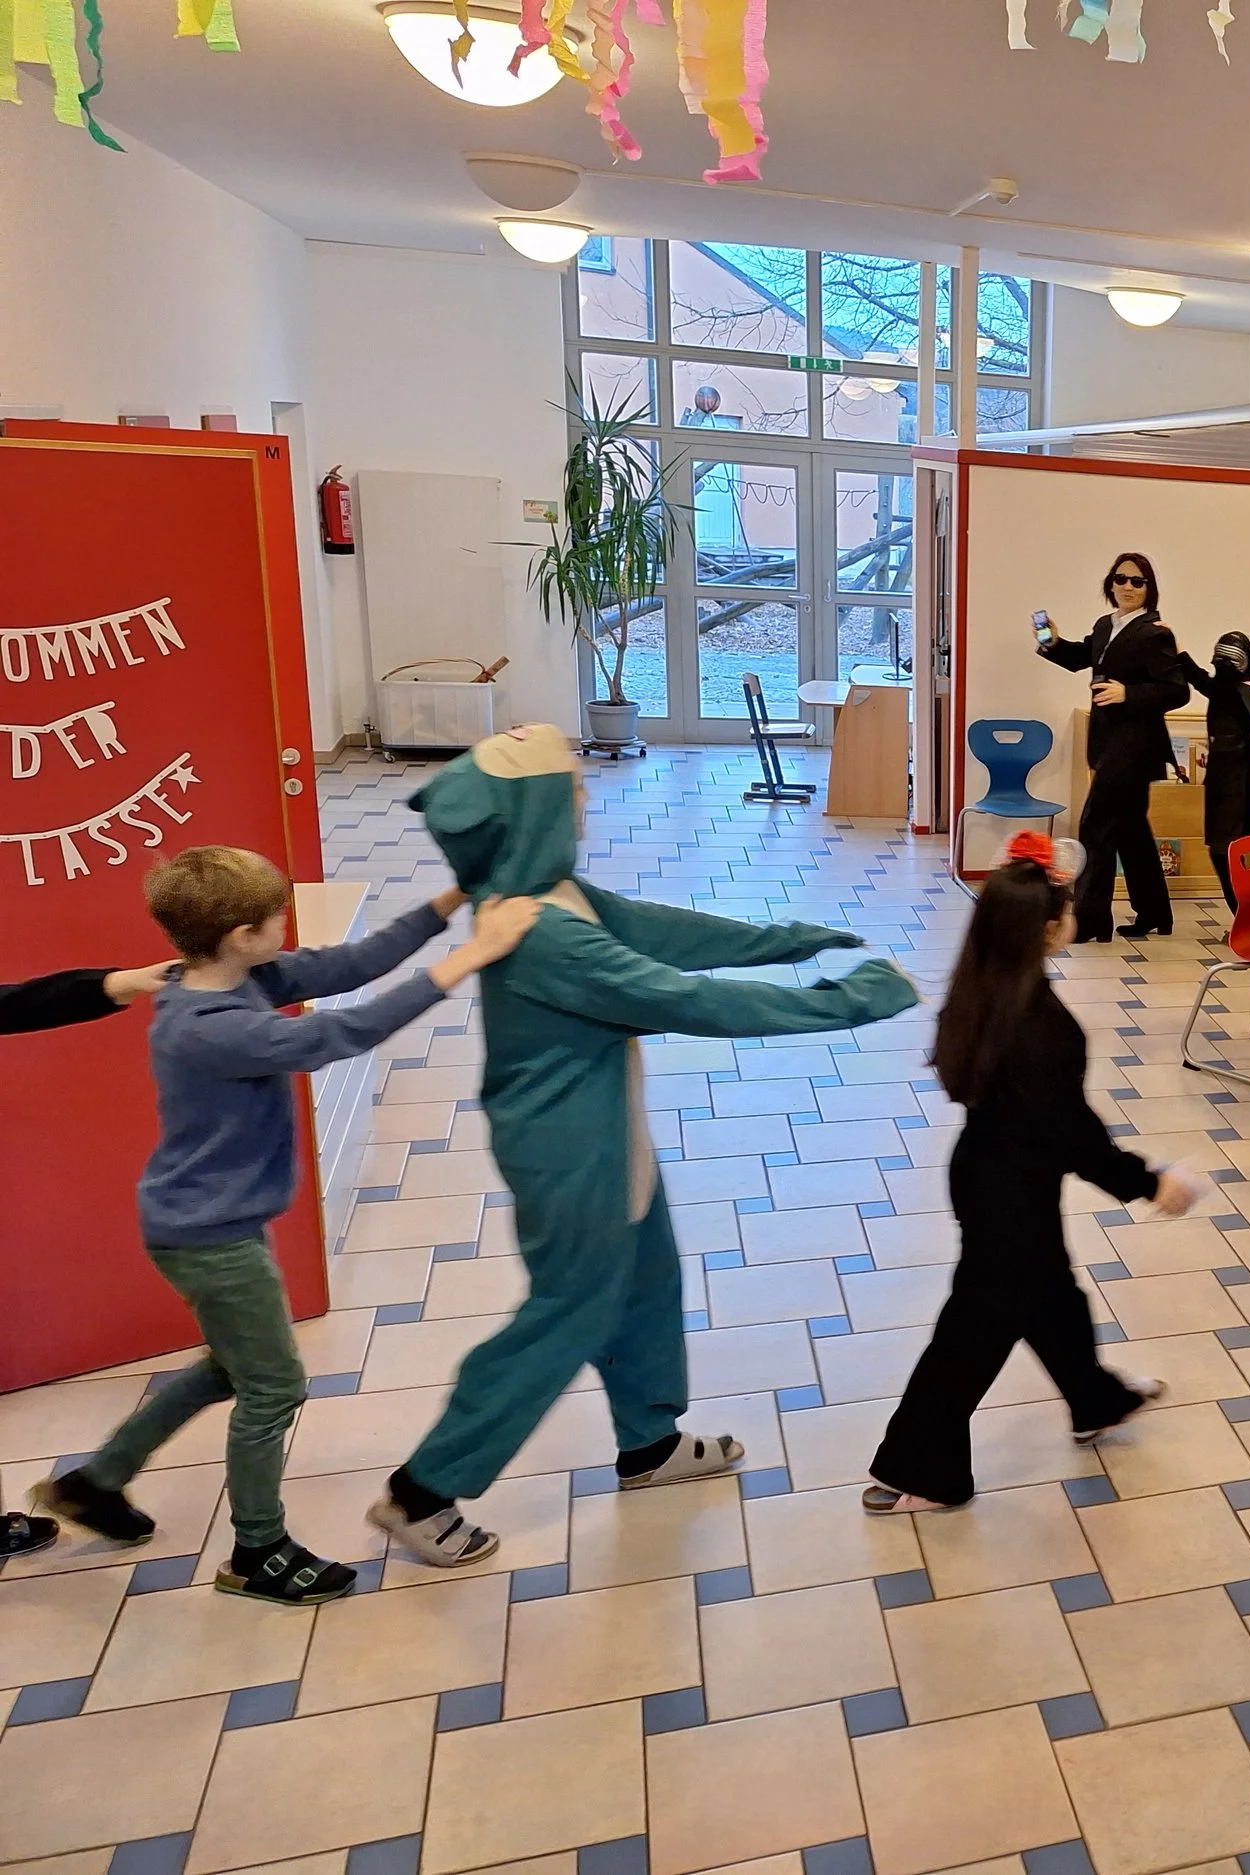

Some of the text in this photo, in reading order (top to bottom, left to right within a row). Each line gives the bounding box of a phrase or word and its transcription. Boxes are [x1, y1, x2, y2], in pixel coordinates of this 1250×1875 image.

[265, 446, 281, 460] M
[0, 604, 186, 682] OMMEN
[12, 710, 127, 778] DER
[21, 780, 193, 886] LASSE
